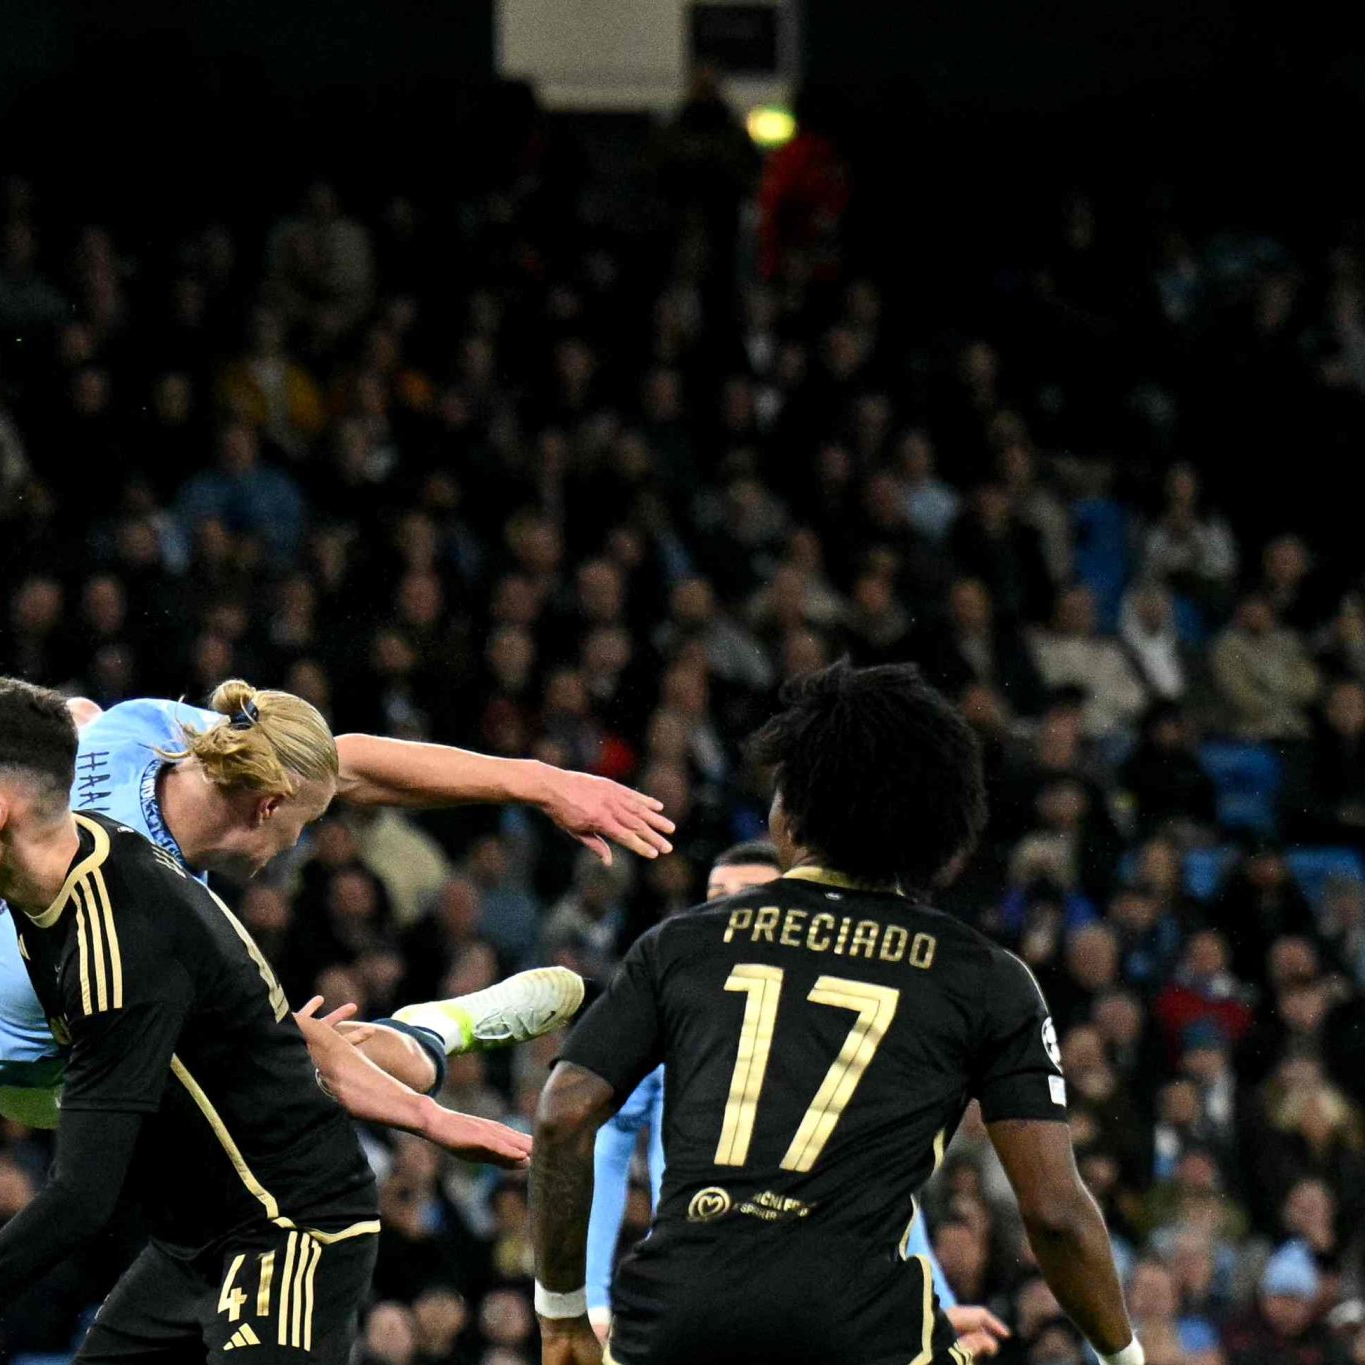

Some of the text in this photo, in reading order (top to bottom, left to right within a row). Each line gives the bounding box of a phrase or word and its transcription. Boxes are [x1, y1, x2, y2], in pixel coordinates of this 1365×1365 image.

[723, 906, 937, 970] PRECIADO
[713, 962, 901, 1173] 17
[216, 1249, 276, 1323] 41
